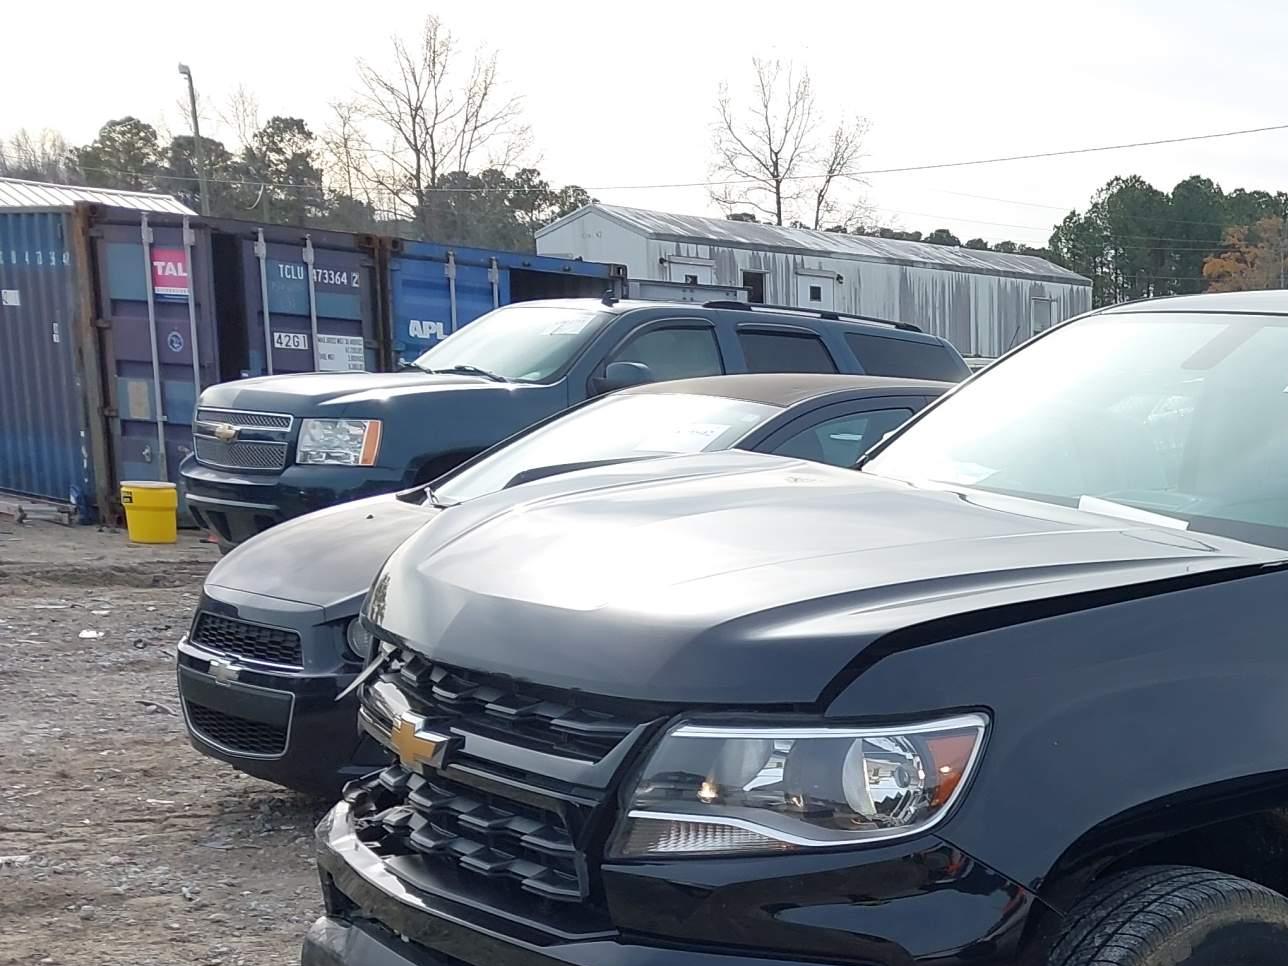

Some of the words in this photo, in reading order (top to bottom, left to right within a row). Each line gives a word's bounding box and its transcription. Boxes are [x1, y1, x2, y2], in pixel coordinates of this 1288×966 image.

[153, 261, 188, 277] TAL
[278, 263, 304, 280] TCLU
[352, 271, 360, 288] 2
[409, 319, 450, 340] APL
[276, 334, 307, 348] 42G1
